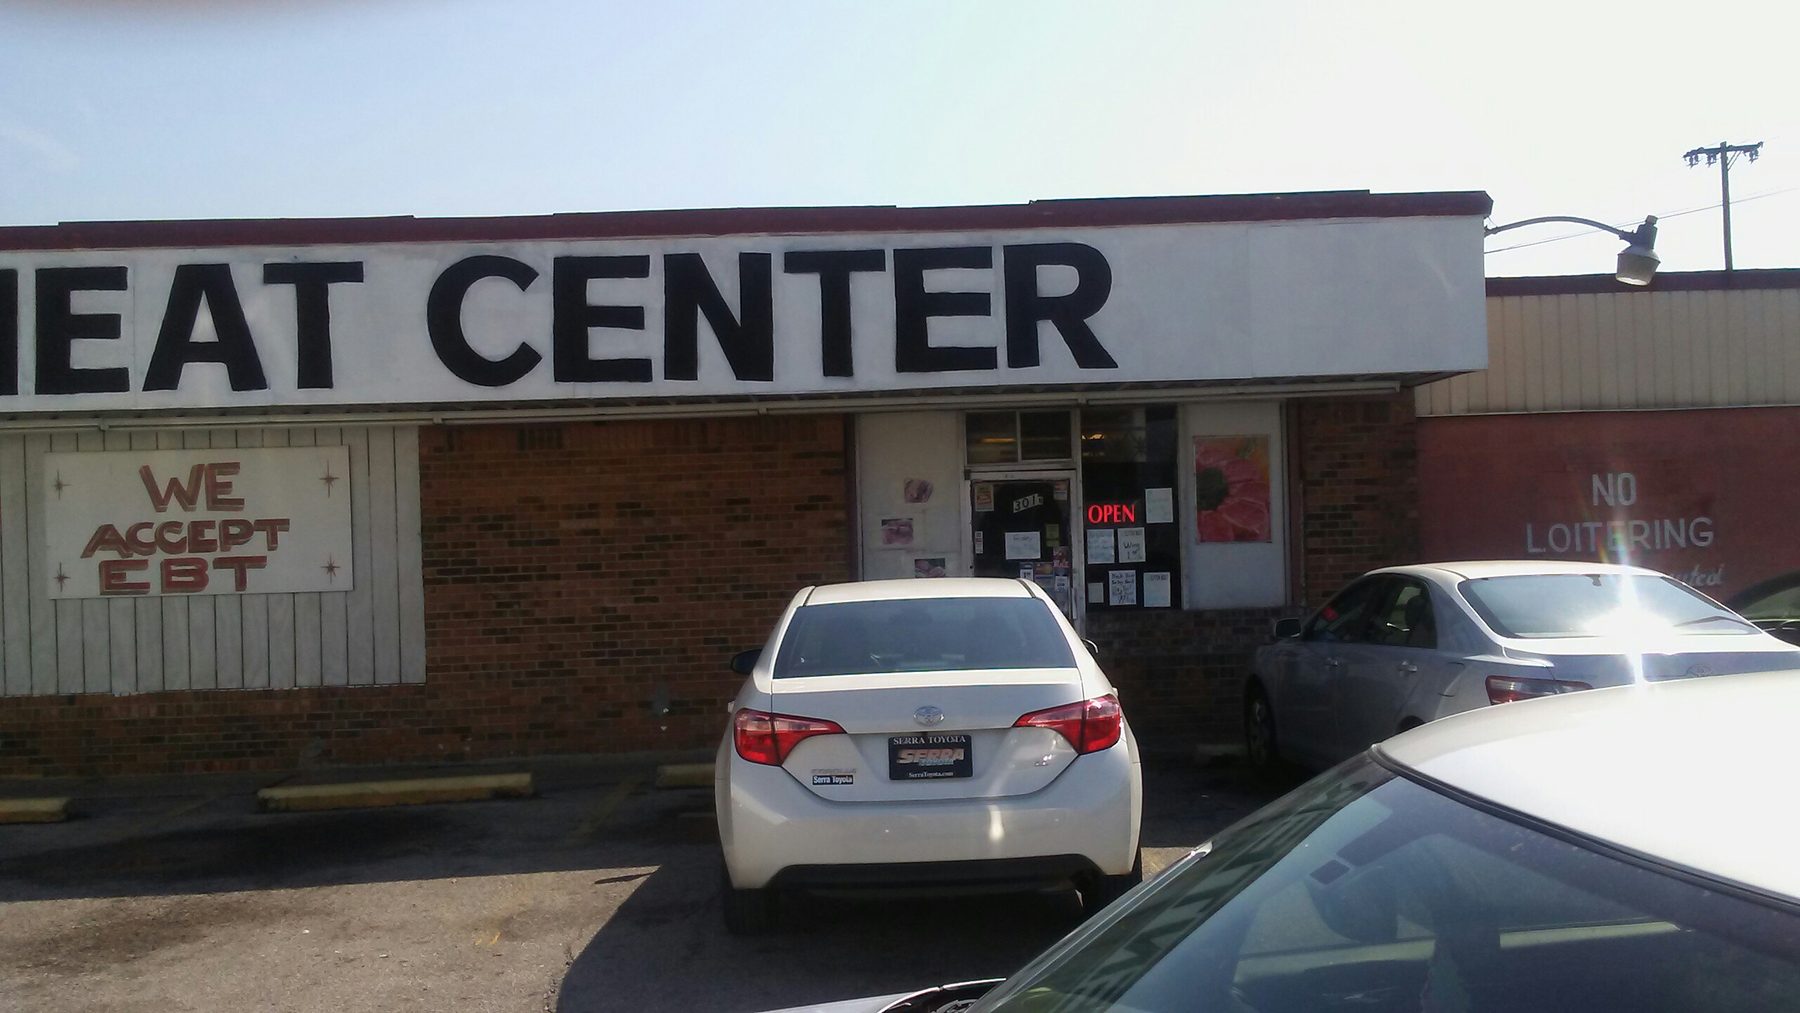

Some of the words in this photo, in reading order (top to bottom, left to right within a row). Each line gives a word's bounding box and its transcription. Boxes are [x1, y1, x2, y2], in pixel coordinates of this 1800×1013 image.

[0, 260, 364, 396] EAT
[427, 243, 1119, 388] CENTER
[138, 461, 245, 513] WE
[1592, 473, 1637, 506] NO
[1087, 503, 1136, 525] OPEN
[80, 518, 291, 559] ACCEPT
[1527, 516, 1714, 554] LOITERING
[98, 555, 268, 596] EBT
[893, 736, 925, 745] SERRA
[927, 735, 966, 744] TOYOTA
[813, 775, 831, 784] Serra
[832, 775, 853, 785] Toyota
